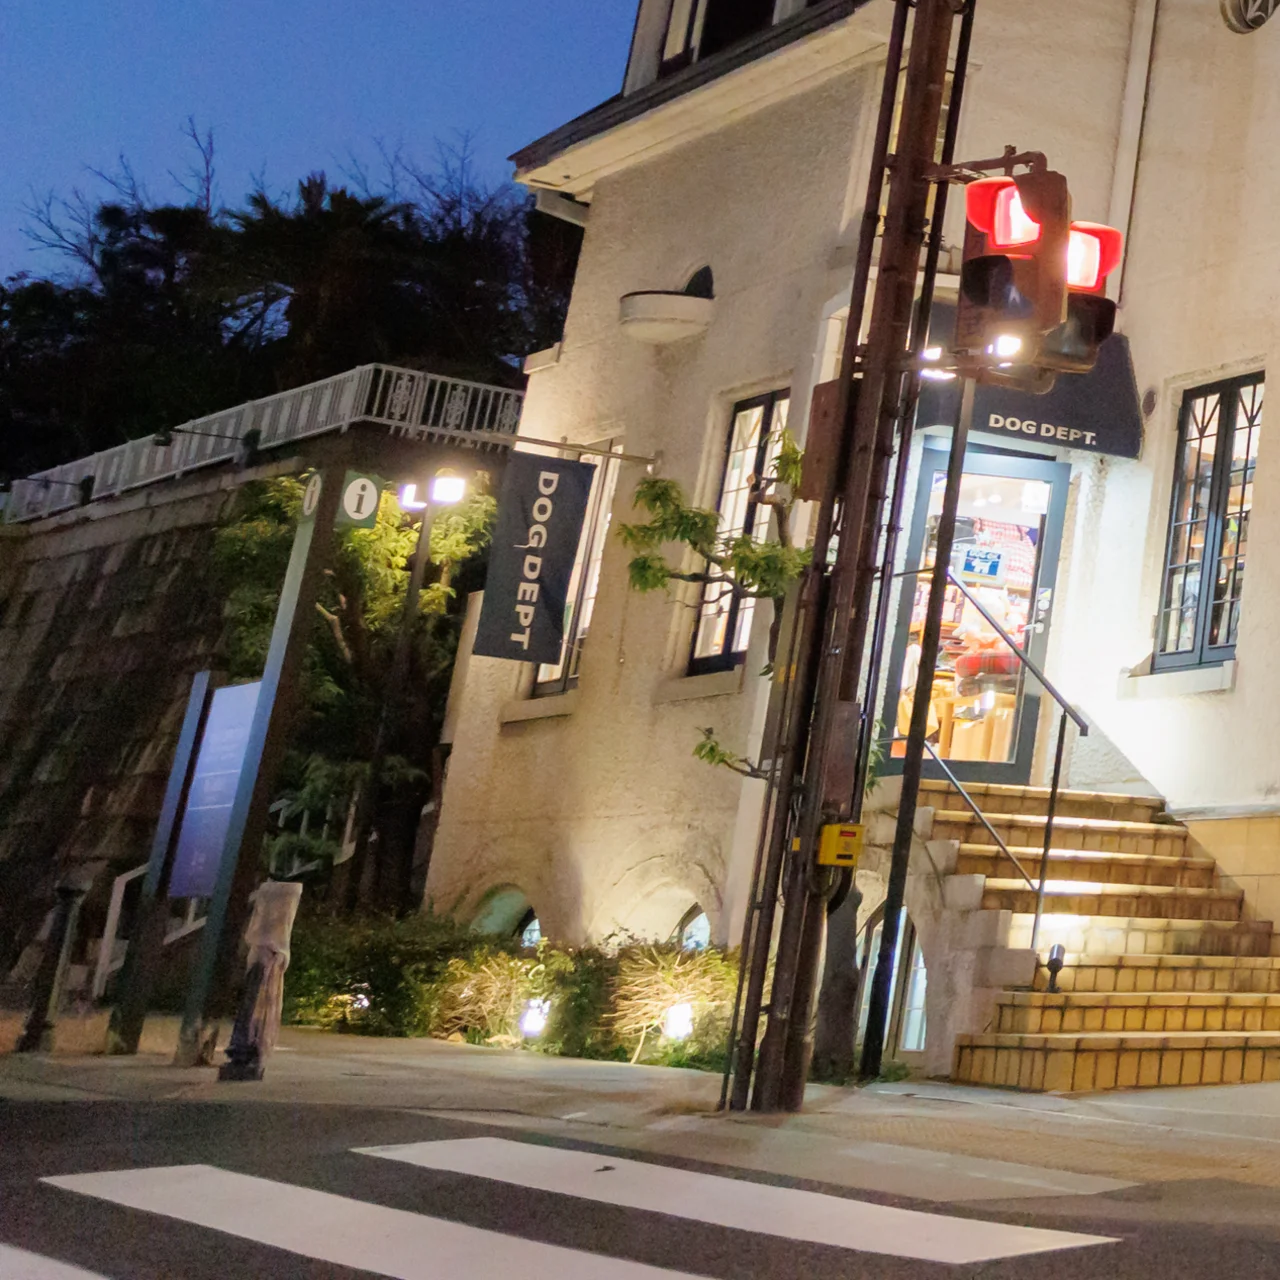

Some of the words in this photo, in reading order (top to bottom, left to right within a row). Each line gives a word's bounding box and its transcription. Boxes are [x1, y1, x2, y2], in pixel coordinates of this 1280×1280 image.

[989, 414, 1037, 434] DOG
[528, 471, 560, 549] DOG
[510, 555, 543, 650] DEPT
